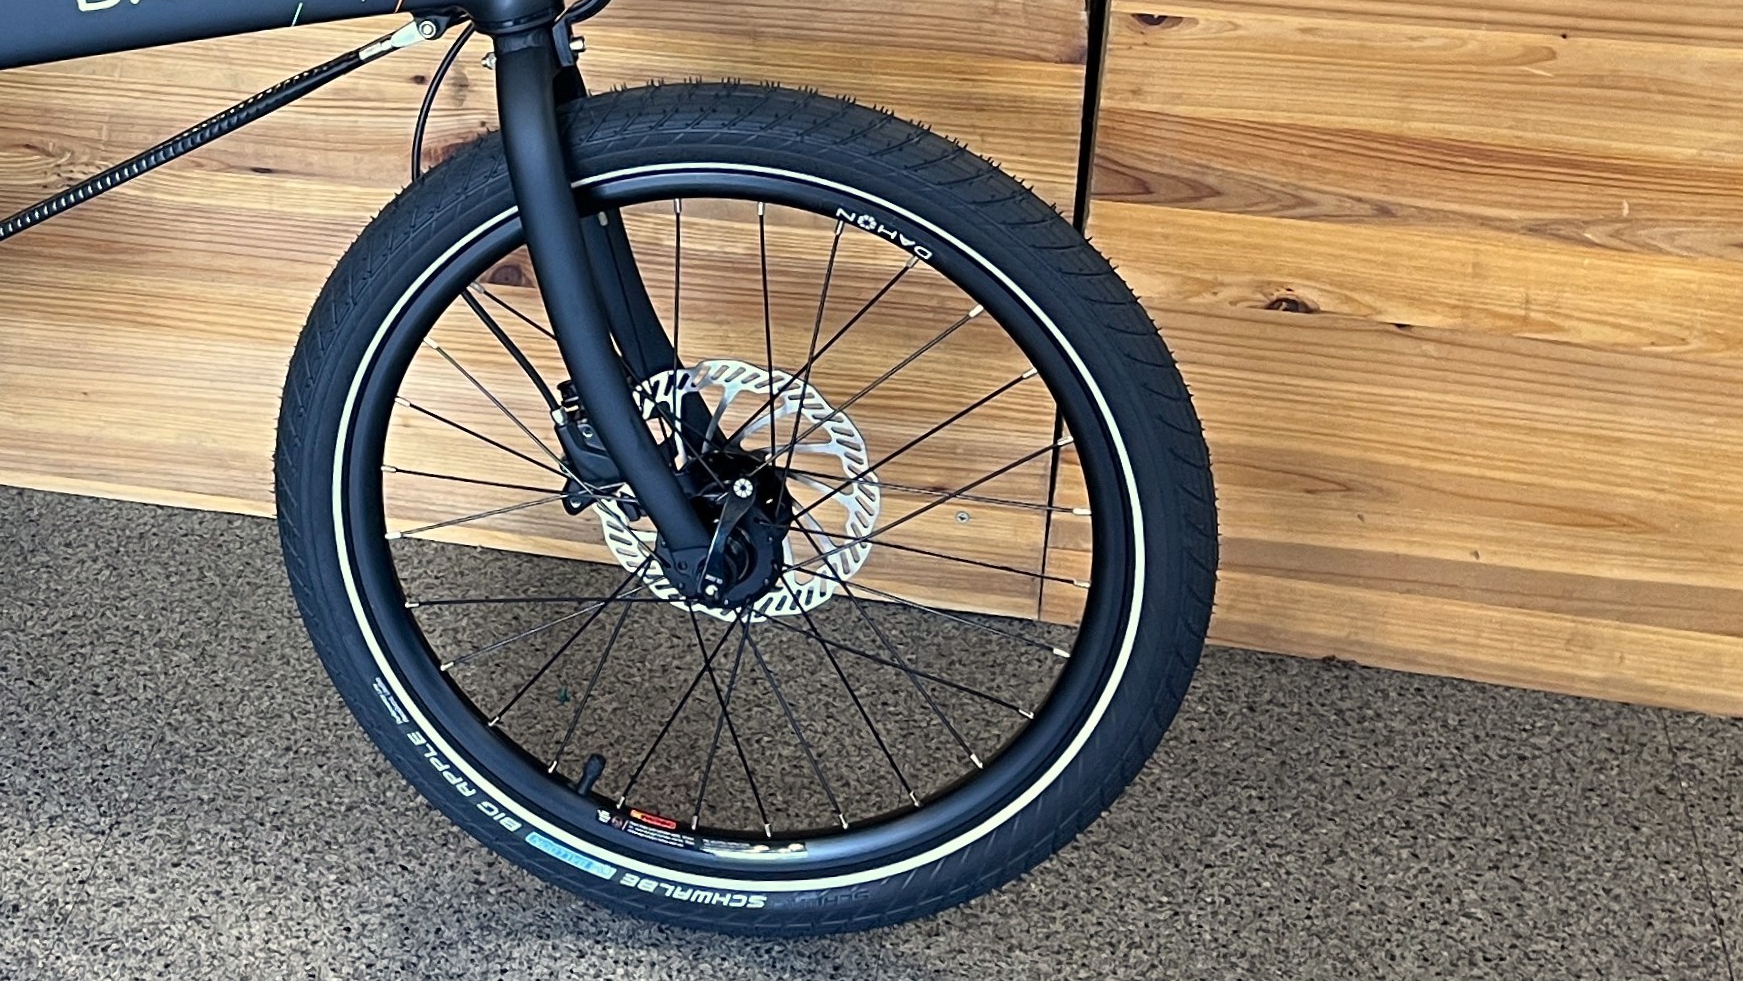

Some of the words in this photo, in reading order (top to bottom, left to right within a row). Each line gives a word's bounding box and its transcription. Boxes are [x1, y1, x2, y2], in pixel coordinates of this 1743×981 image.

[835, 207, 933, 260] DAHON
[406, 731, 477, 797] APPLE
[476, 800, 523, 833] BIG
[619, 872, 768, 909] SCHWALBE
